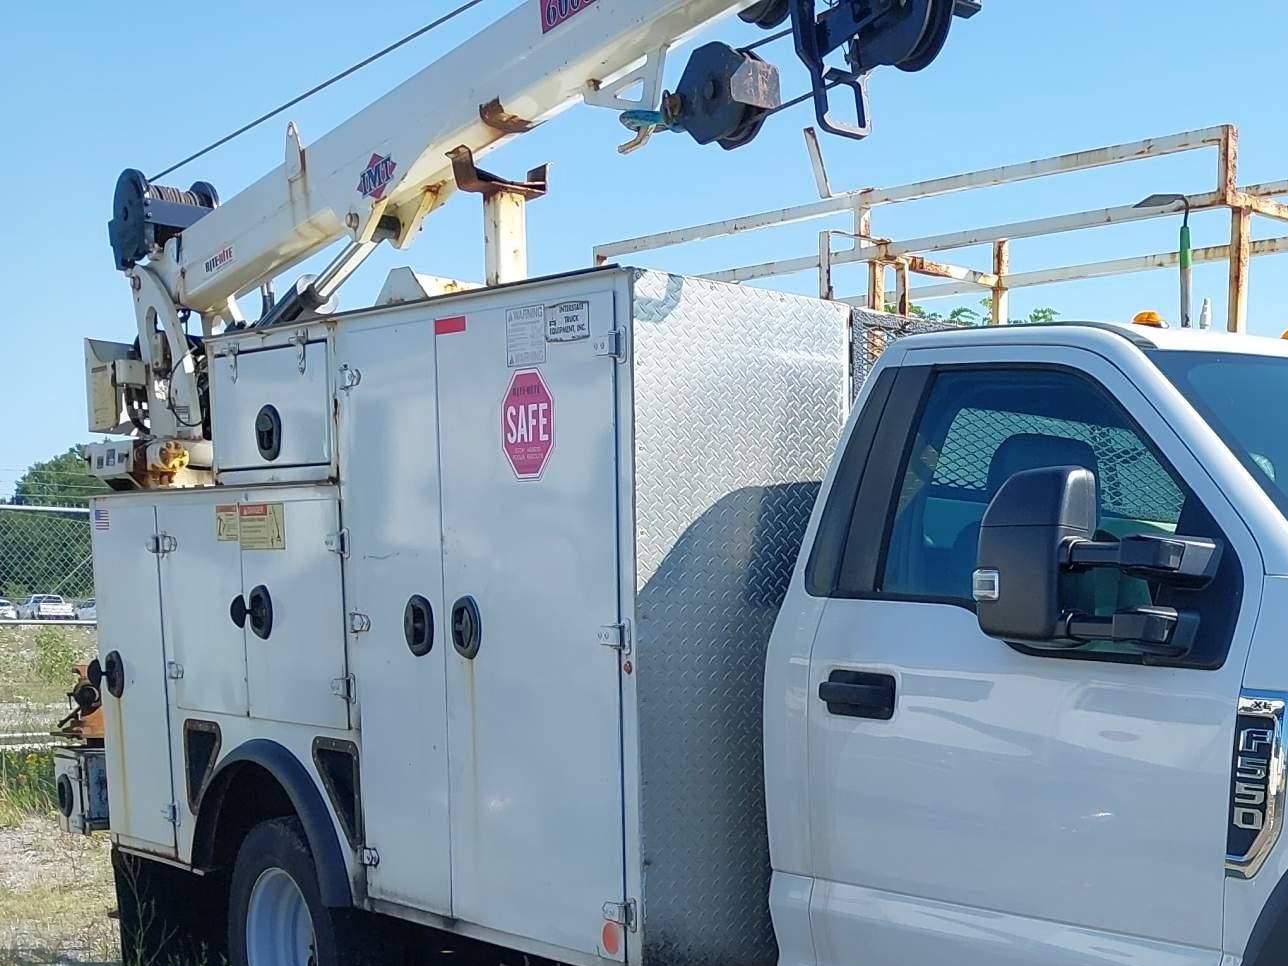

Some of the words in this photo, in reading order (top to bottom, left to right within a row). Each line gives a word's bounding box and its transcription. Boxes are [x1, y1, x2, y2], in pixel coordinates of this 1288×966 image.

[360, 155, 392, 197] IMT
[512, 306, 543, 321] WARNING
[559, 303, 584, 313] INTERSTATE
[564, 315, 579, 323] TRUCK
[507, 402, 549, 444] SAFE
[1232, 728, 1273, 830] F550
